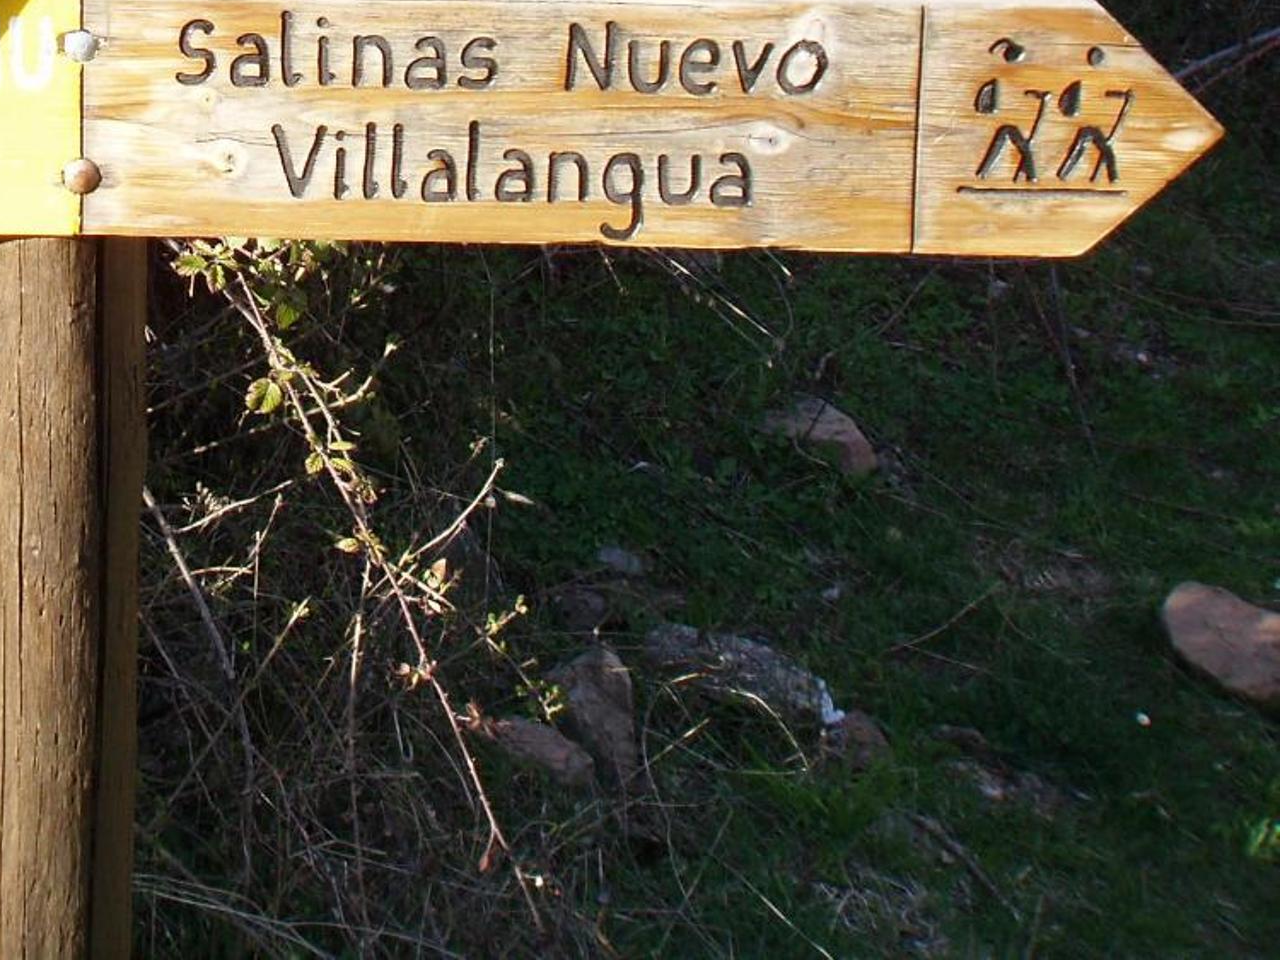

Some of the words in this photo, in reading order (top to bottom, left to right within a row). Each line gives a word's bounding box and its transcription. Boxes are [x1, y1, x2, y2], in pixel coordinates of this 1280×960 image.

[176, 10, 499, 91] Salinas
[563, 19, 829, 96] Nuevo
[271, 119, 754, 240] Villalangua
